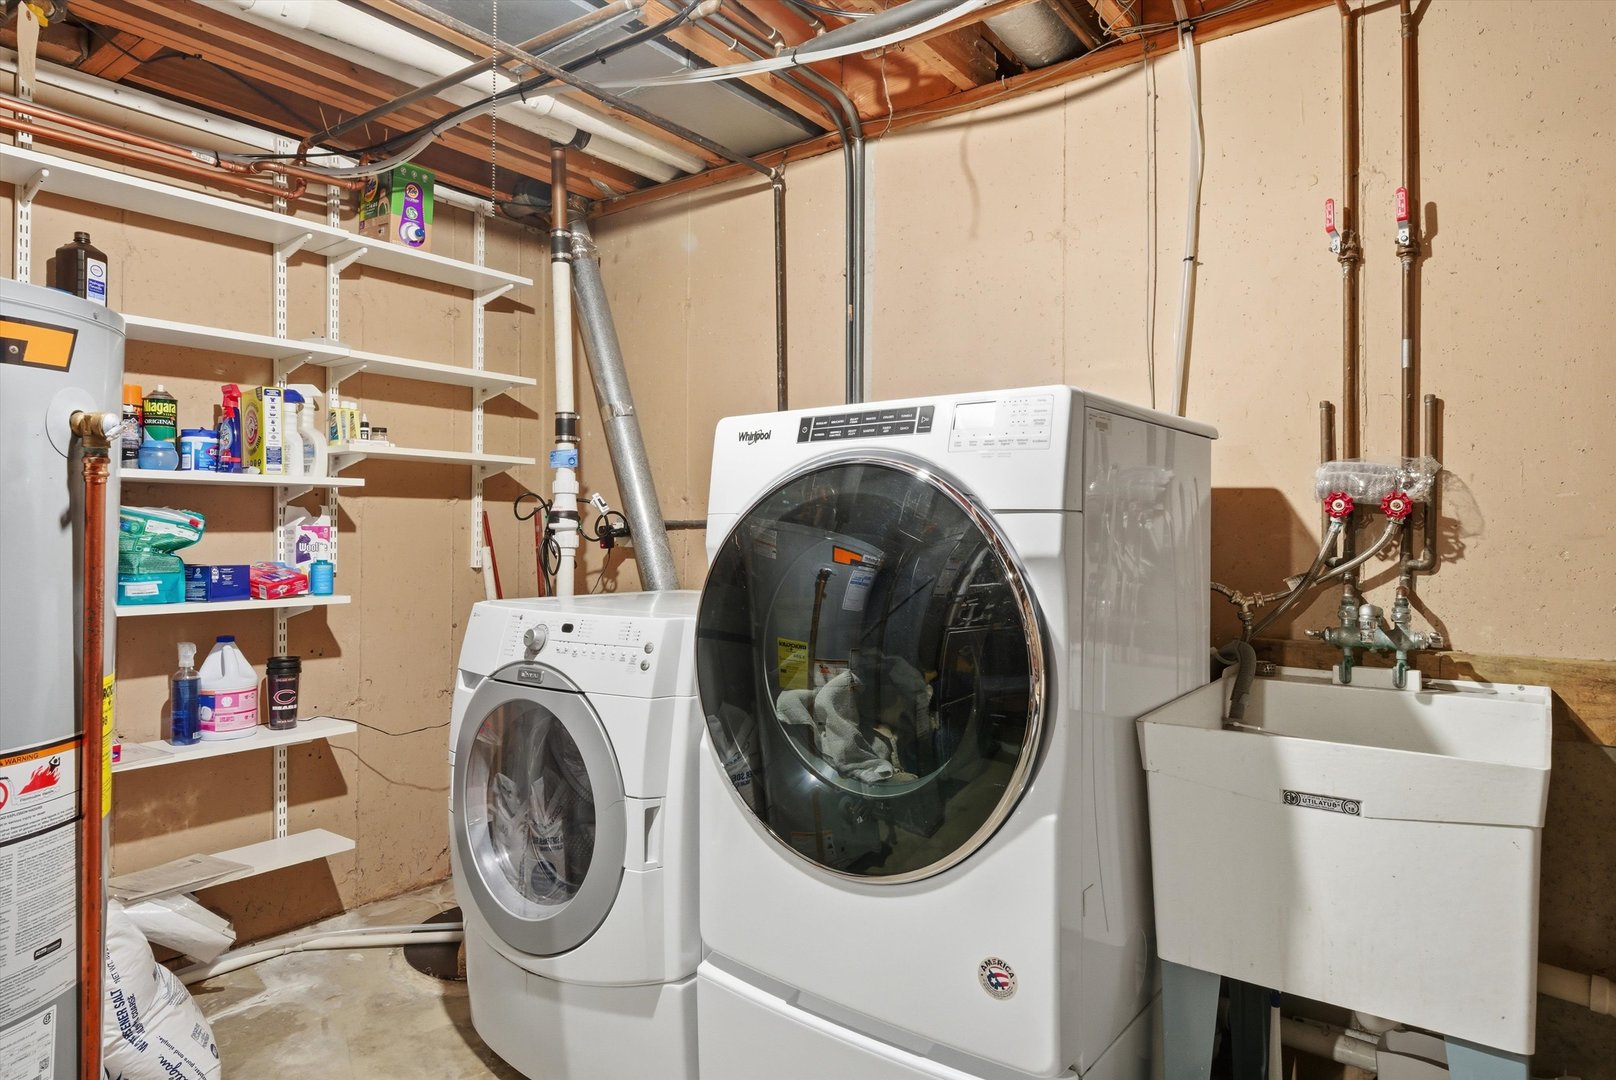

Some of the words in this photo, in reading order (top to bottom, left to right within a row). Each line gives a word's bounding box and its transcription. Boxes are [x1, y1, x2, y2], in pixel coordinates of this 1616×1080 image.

[143, 399, 177, 415] Niagara
[144, 418, 175, 426] ORIGINAL
[738, 429, 772, 446] Whirlpool
[299, 541, 329, 552] Woole
[4, 752, 39, 765] WARNING
[1302, 798, 1337, 808] UTILATUB
[980, 958, 1015, 979] AMERICA
[109, 988, 126, 1009] SALT
[127, 993, 139, 1019] COARSE
